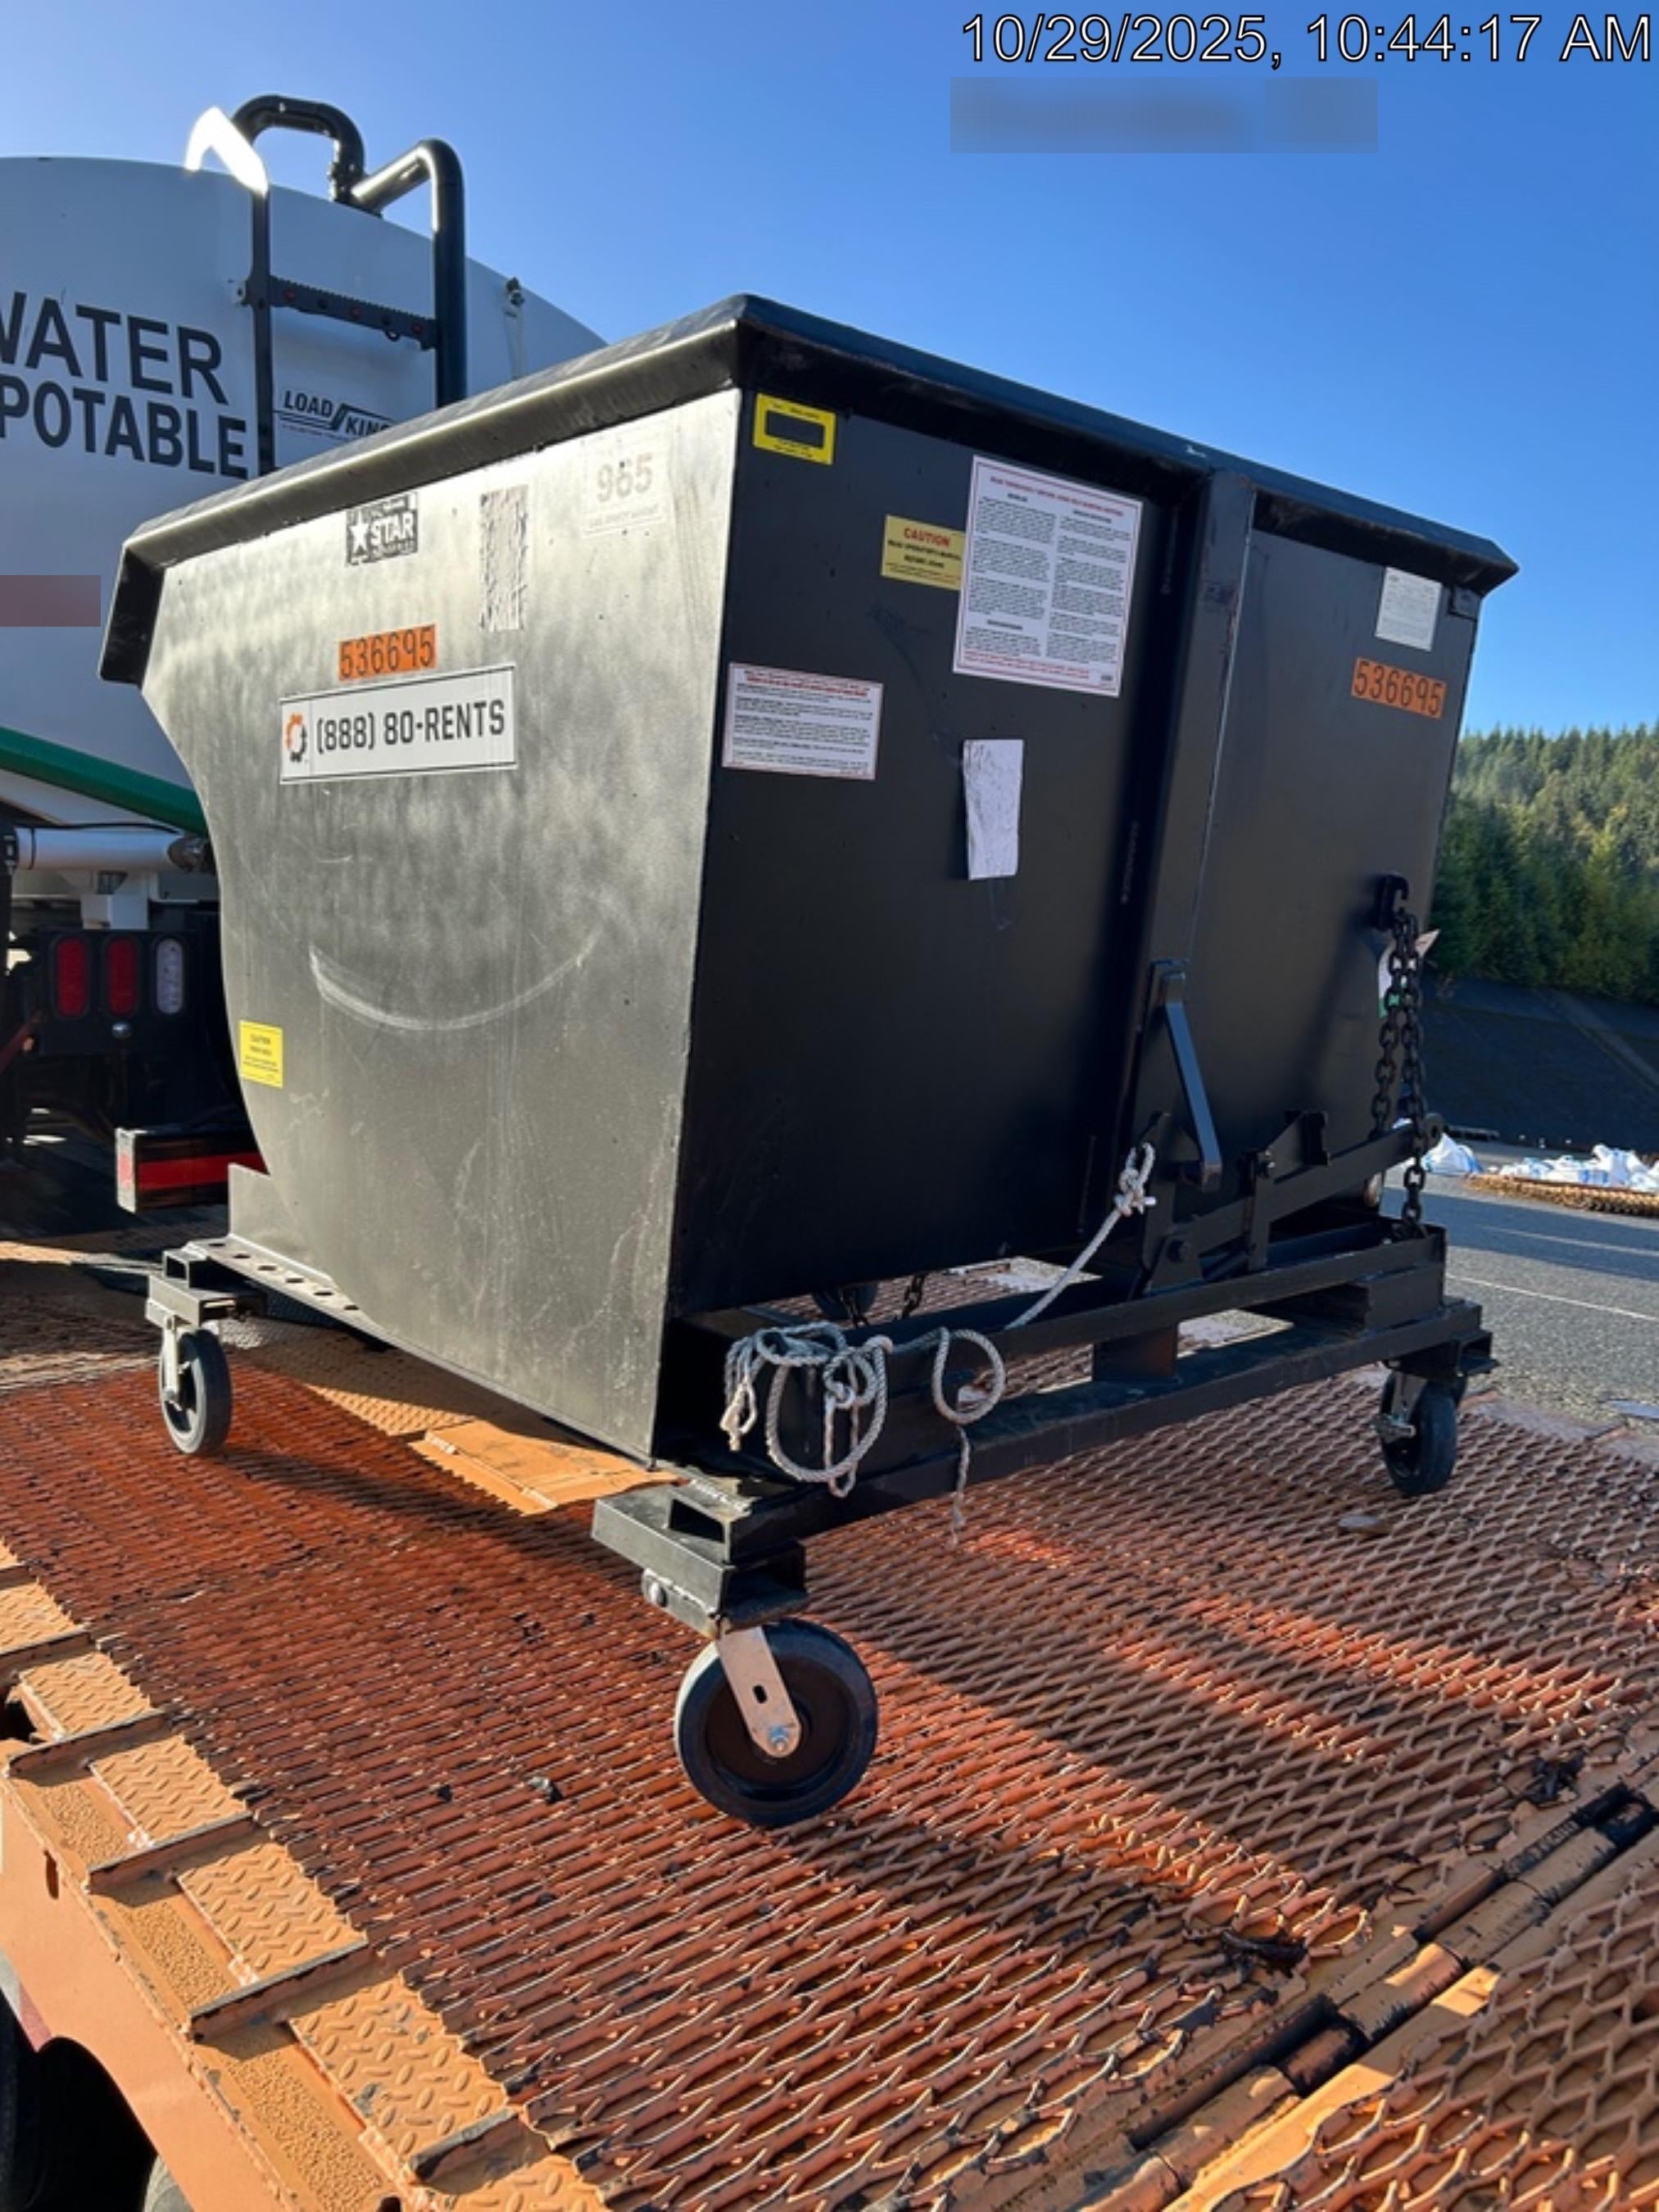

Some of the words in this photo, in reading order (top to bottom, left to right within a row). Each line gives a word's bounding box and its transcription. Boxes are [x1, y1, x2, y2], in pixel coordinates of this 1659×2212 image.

[0, 373, 248, 480] POTABLE
[283, 390, 333, 418] LOAD
[596, 451, 653, 502] 965
[369, 511, 414, 546] STAR
[904, 527, 951, 547] CAUTION
[339, 628, 436, 678] 536695
[1353, 660, 1443, 717] 536695
[316, 712, 375, 755] (888)
[383, 699, 505, 746] 80-RENTS
